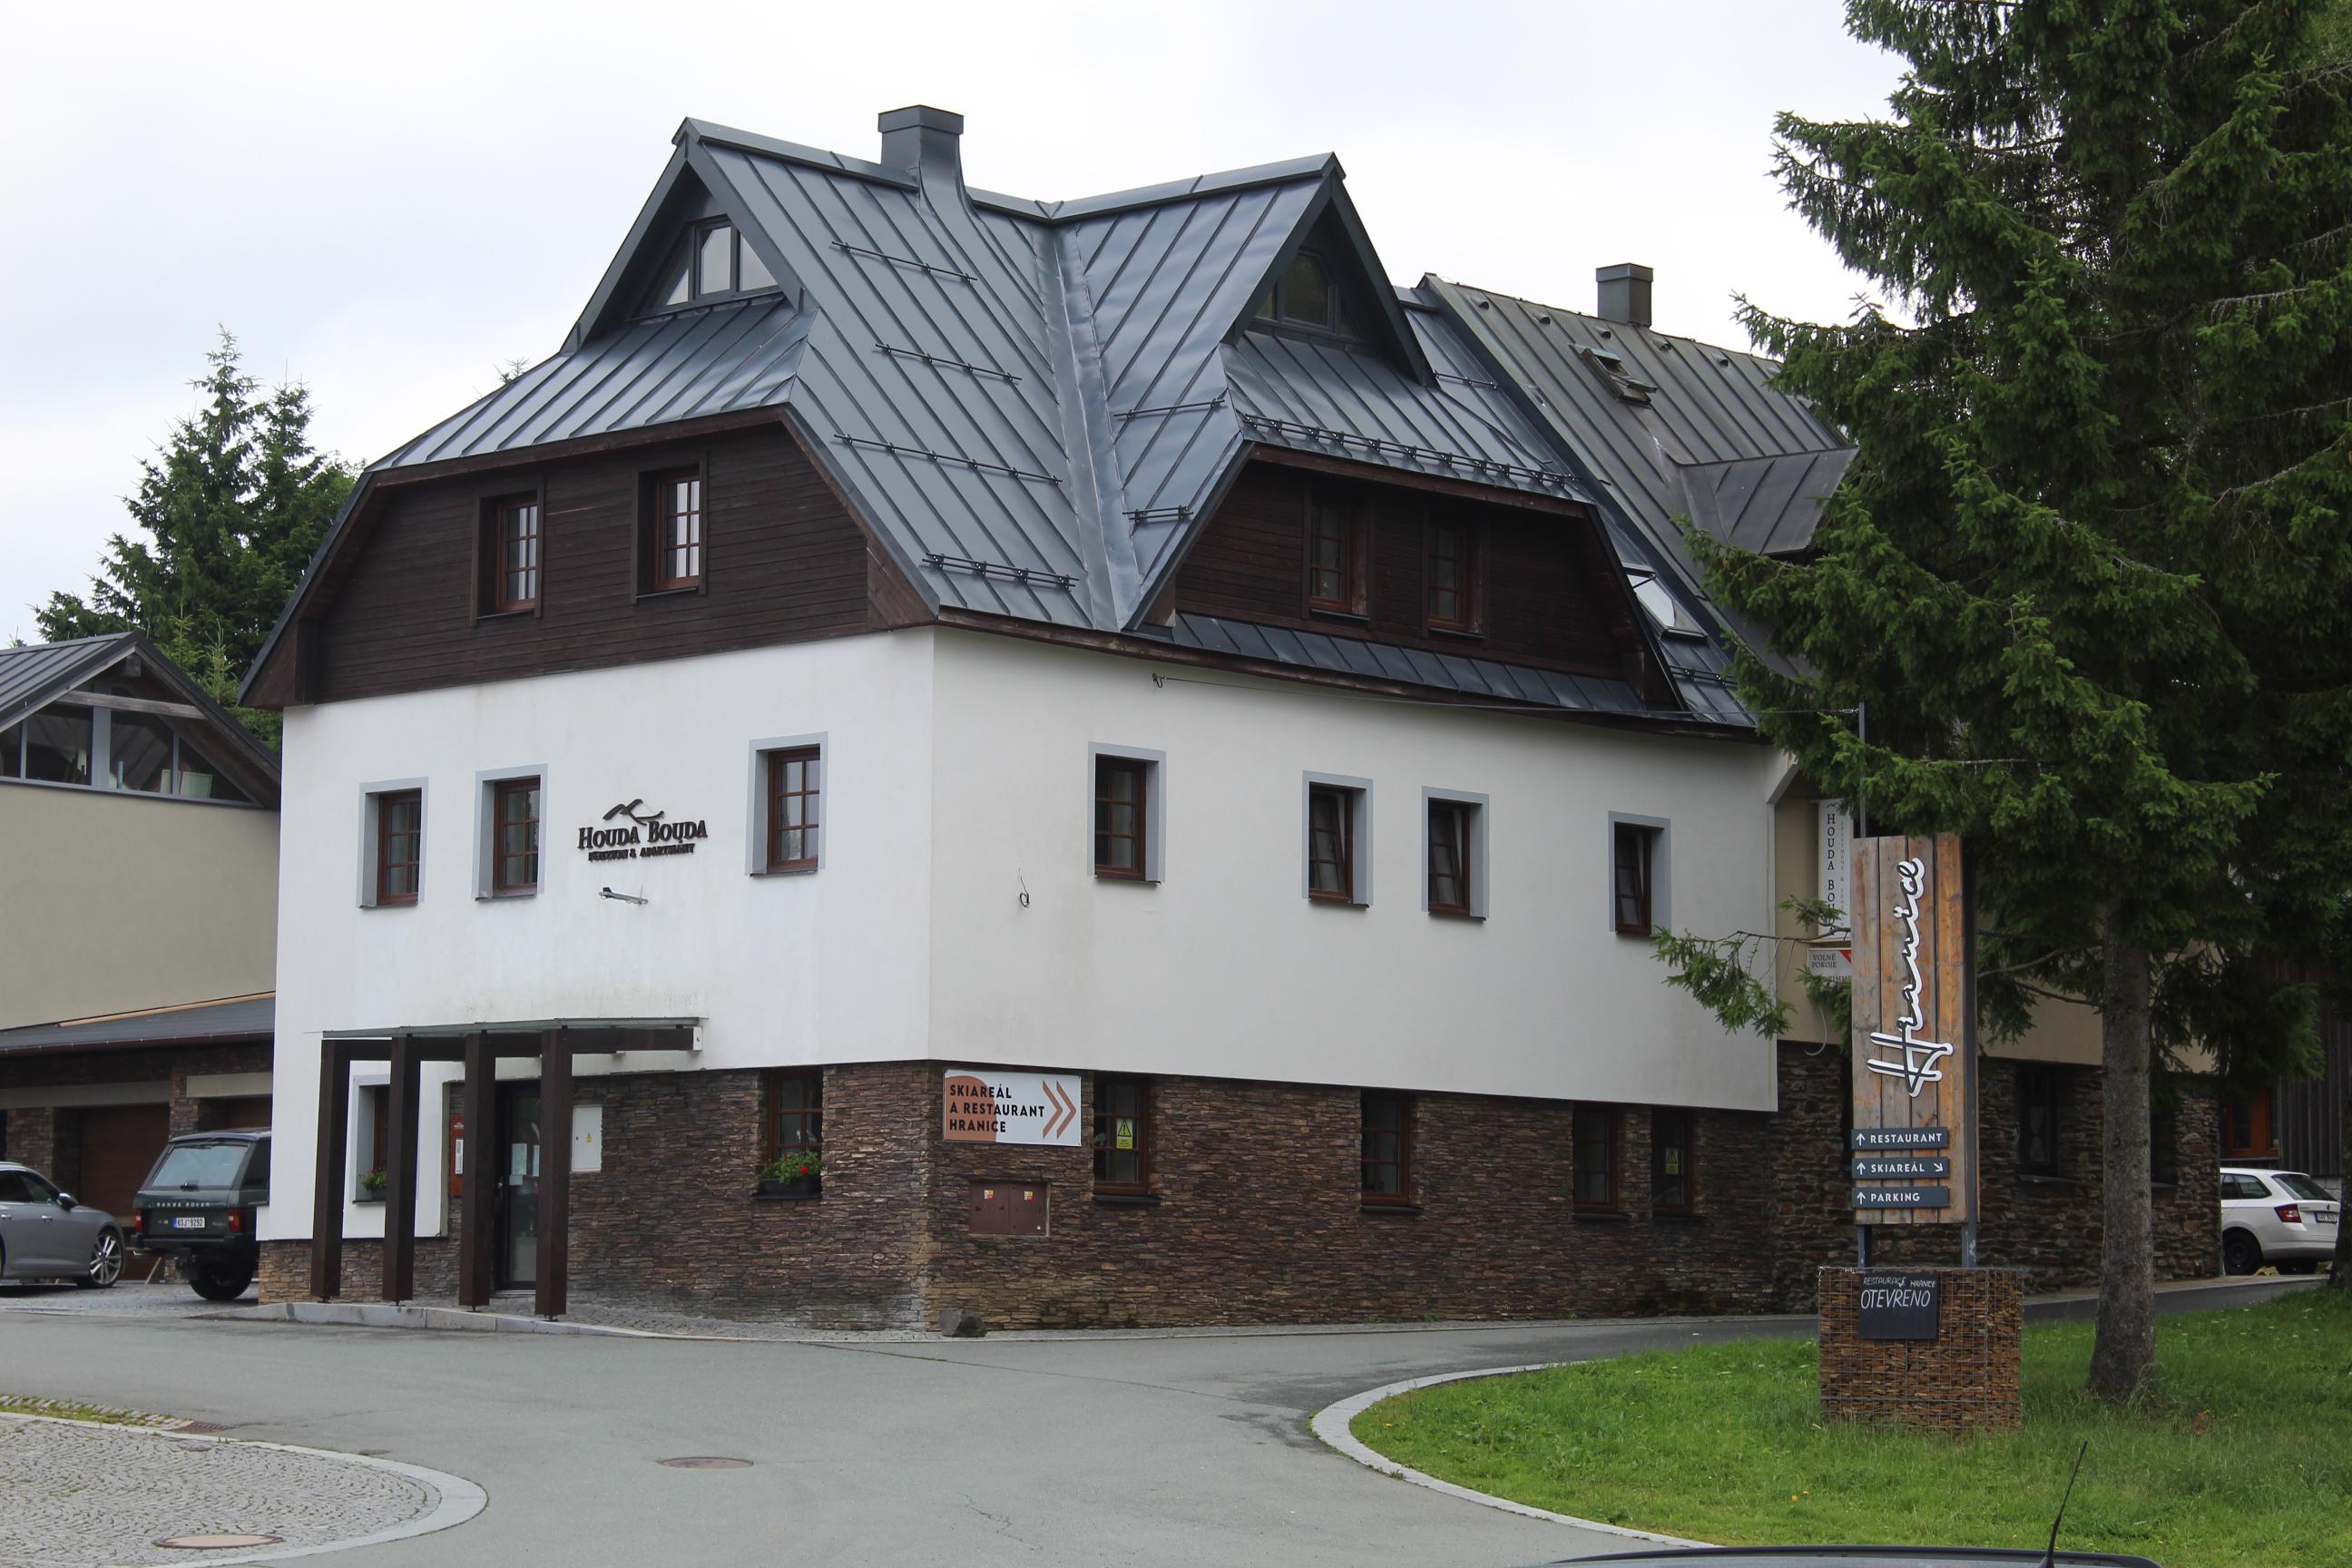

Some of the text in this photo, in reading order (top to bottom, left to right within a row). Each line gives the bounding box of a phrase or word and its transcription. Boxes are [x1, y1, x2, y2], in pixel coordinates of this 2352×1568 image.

[577, 819, 708, 849] HOUDA BOUDA
[1827, 813, 1836, 870] HOUDA
[629, 848, 636, 858] &
[1867, 857, 1954, 1098] Hranice
[949, 1083, 1013, 1099] SKIAREÁL
[949, 1102, 1045, 1117] A RESTAURANT
[949, 1119, 1006, 1132] HRANICE
[1870, 1133, 1942, 1143] RESTAURANT
[1871, 1161, 1925, 1173] SKIAREÁL
[1870, 1192, 1920, 1202] PARKING
